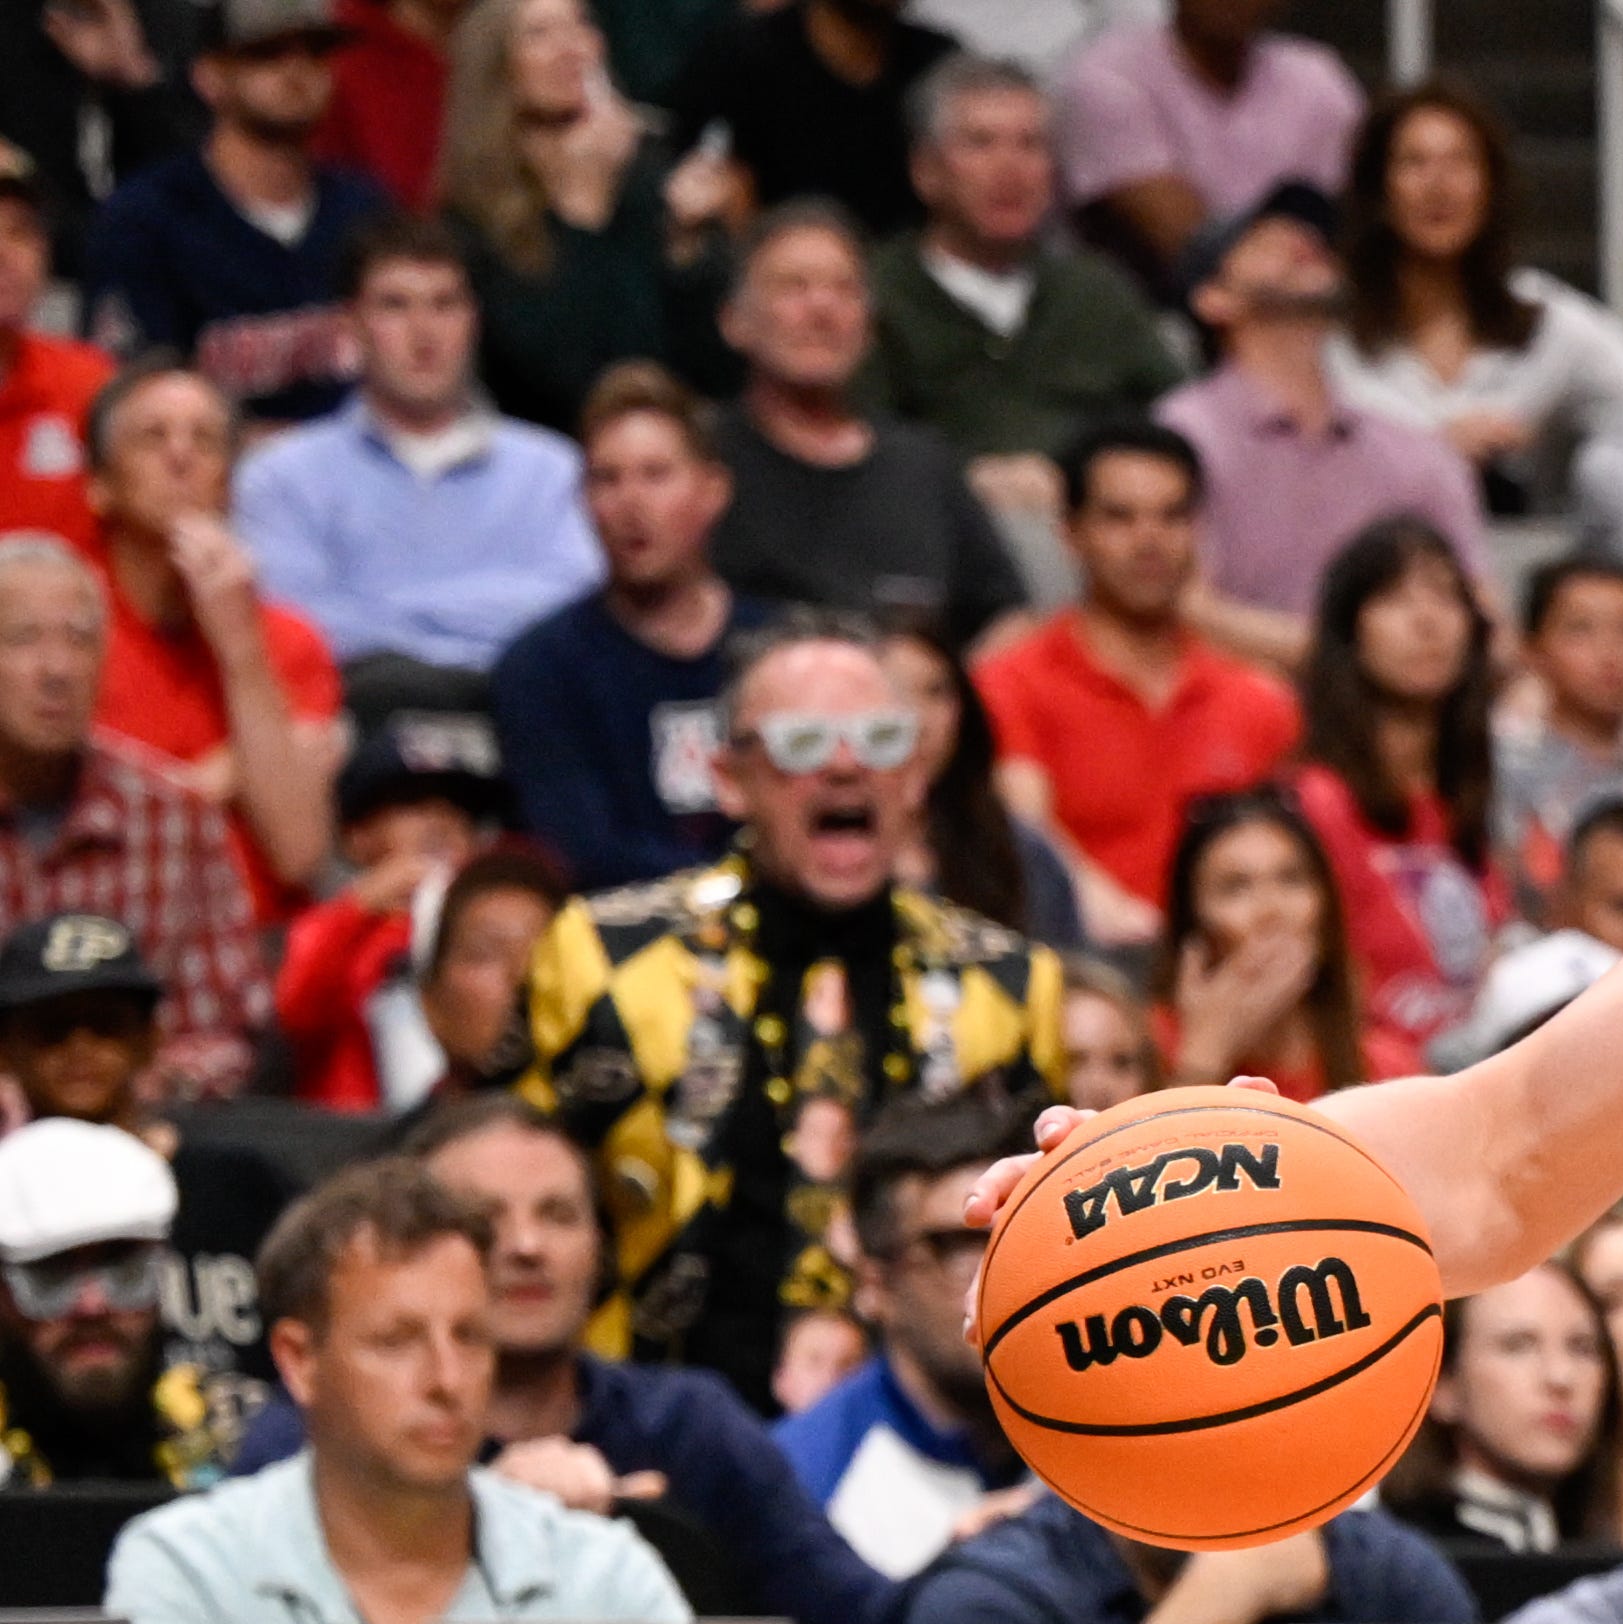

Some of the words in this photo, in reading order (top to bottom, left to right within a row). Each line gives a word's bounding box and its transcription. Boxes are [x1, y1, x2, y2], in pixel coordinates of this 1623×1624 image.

[1062, 1143, 1281, 1240] NCAA
[1151, 1273, 1195, 1293] NXT
[1201, 1260, 1245, 1281] EVO
[1055, 1256, 1371, 1372] Wilson
